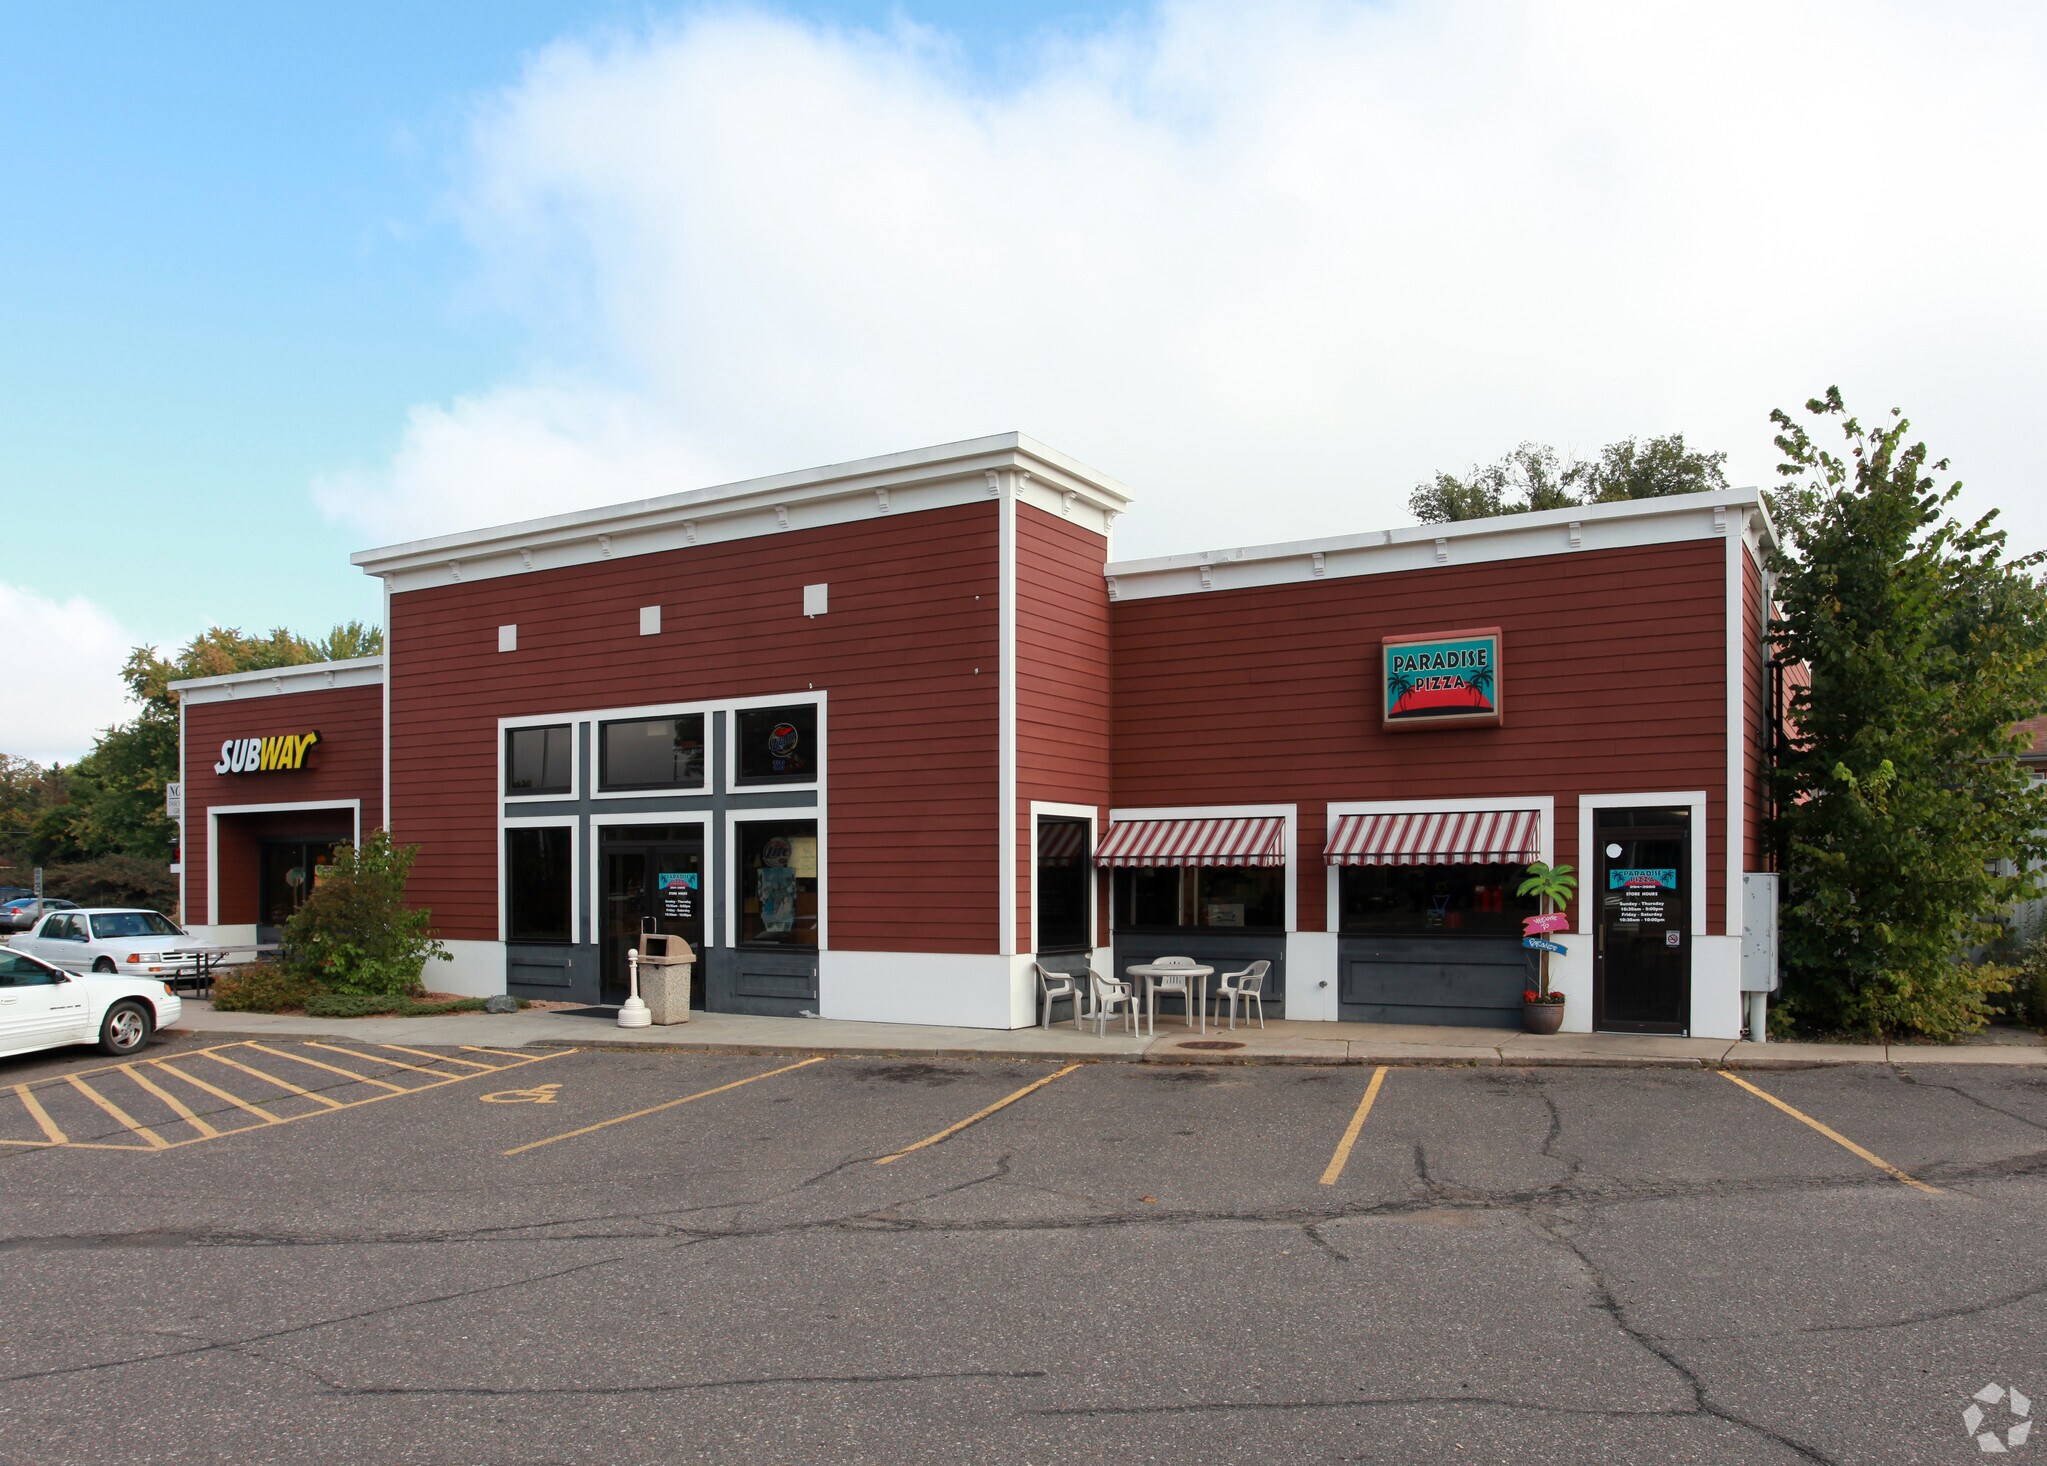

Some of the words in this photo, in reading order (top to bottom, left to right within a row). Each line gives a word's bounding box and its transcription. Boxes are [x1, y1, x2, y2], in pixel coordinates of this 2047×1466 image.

[1393, 648, 1487, 673] PARADISE
[1415, 674, 1466, 691] PIZZA
[213, 731, 318, 775] SUBWAY
